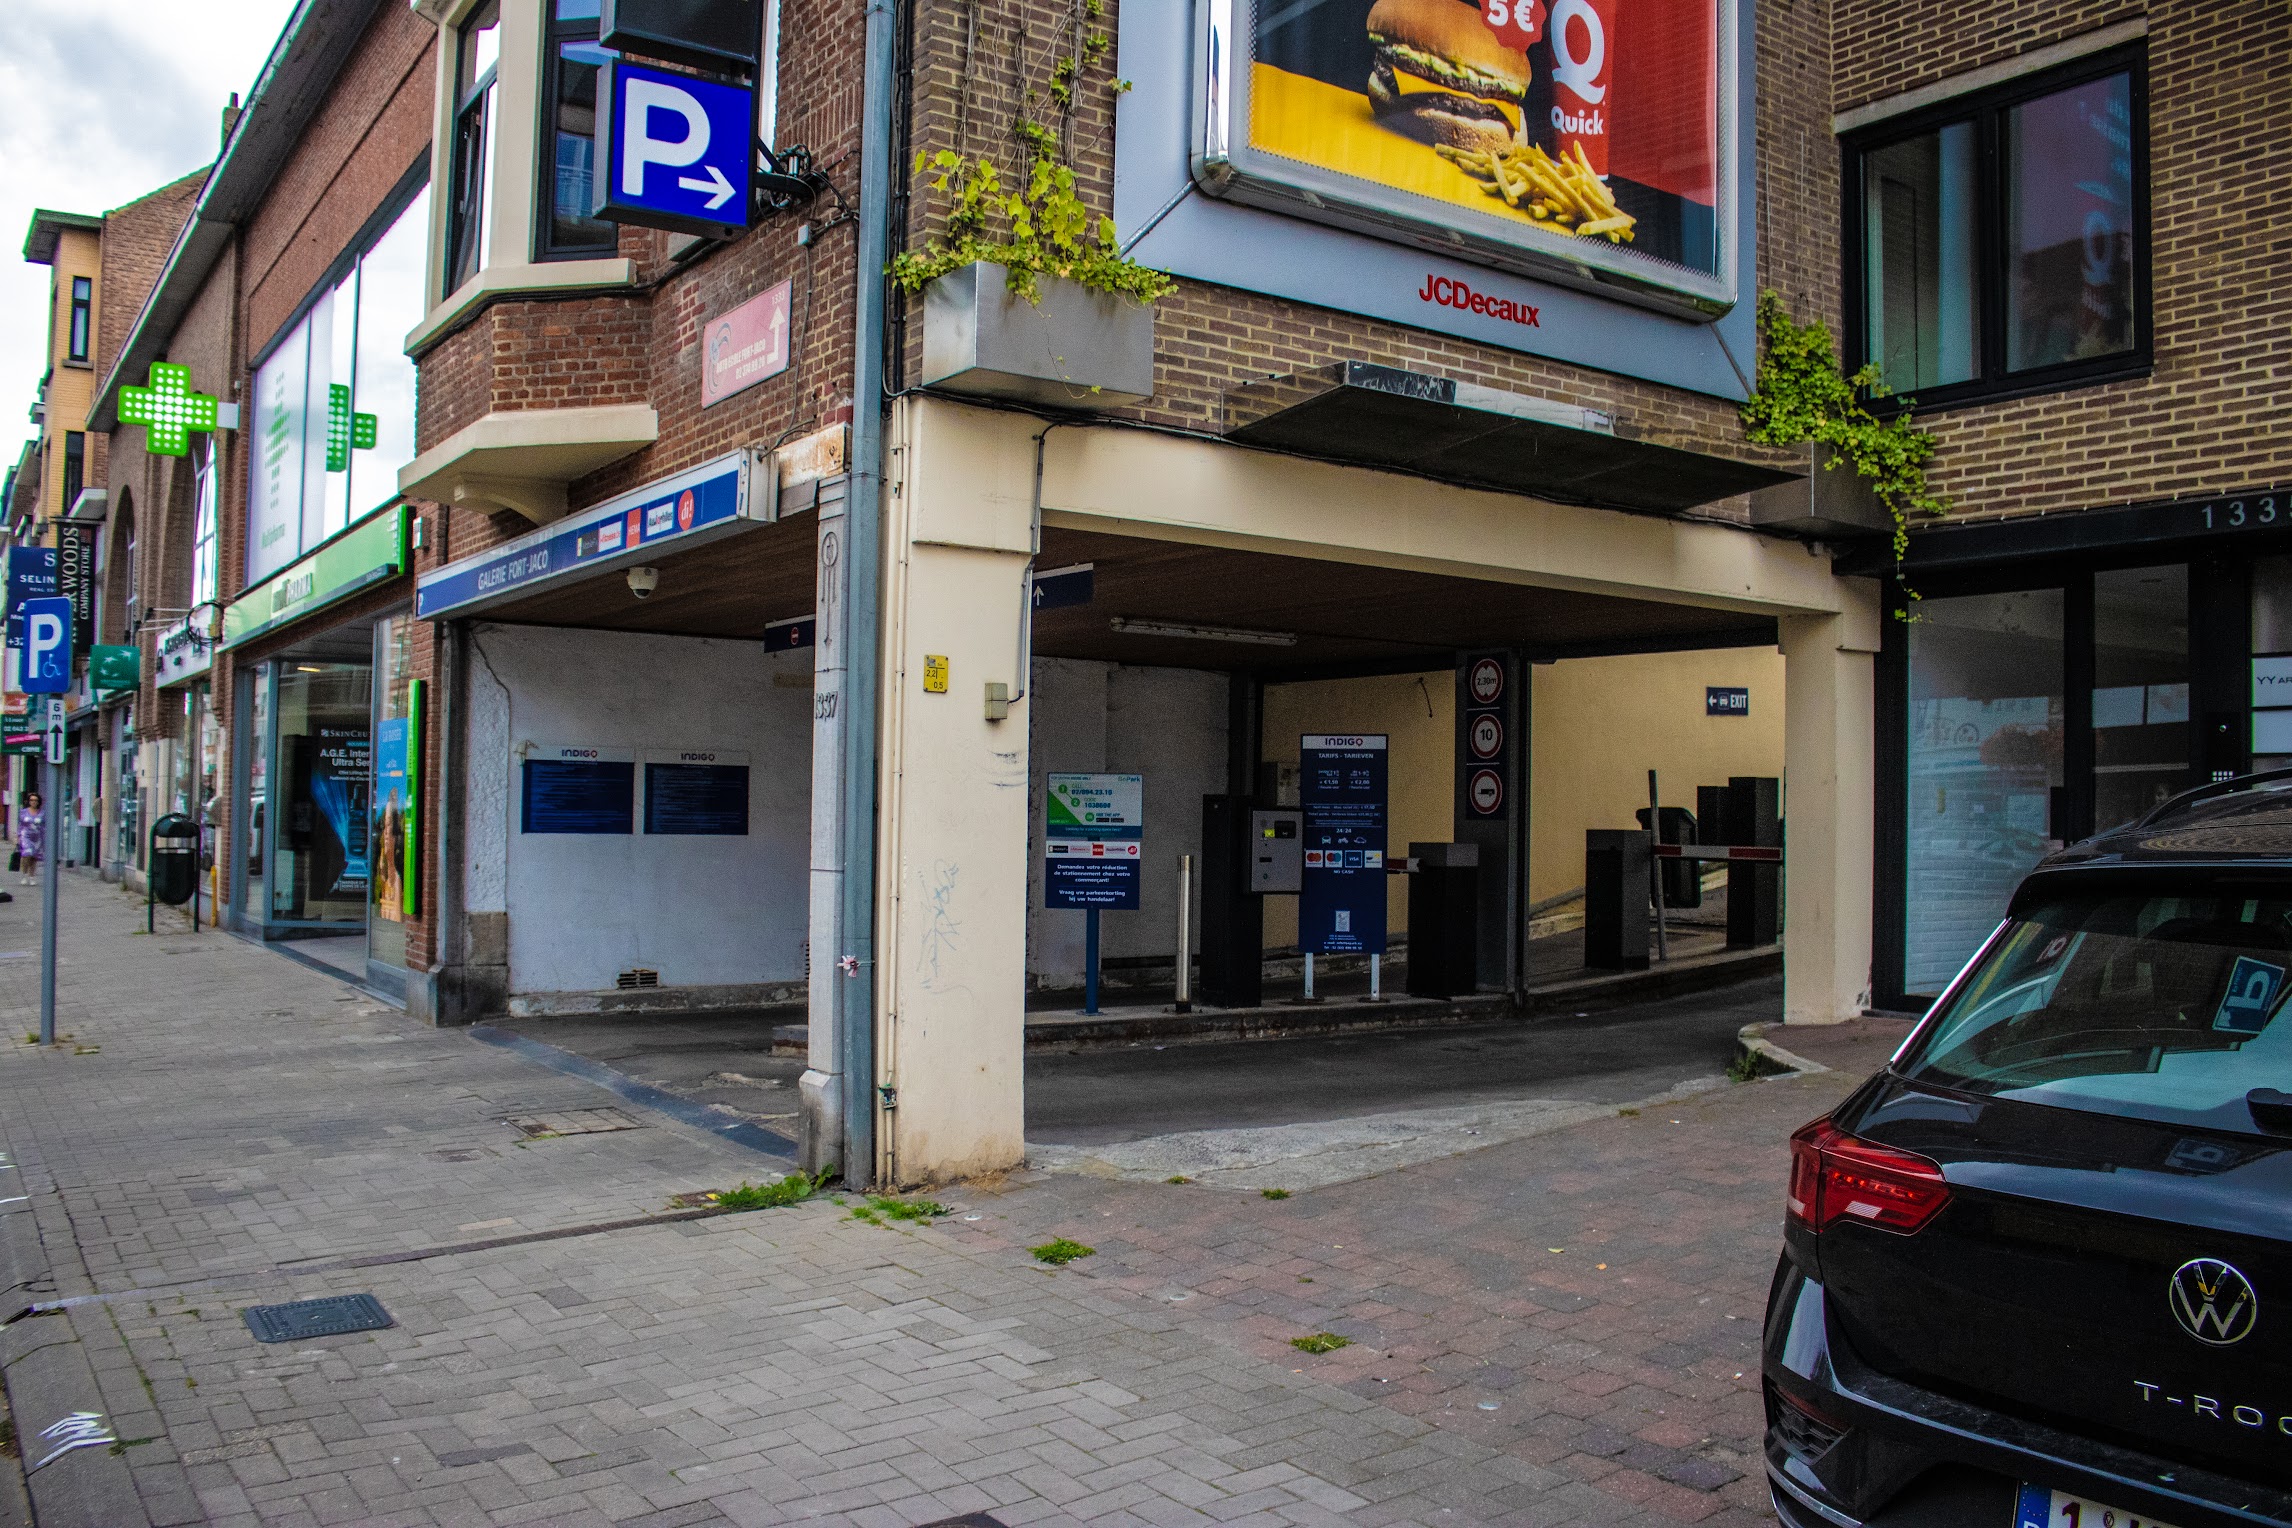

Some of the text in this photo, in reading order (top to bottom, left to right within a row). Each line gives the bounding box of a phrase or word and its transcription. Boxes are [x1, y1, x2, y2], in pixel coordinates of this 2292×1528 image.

[1551, 106, 1604, 135] Quick
[622, 77, 711, 197] P
[1418, 274, 1540, 328] JCDecaux
[681, 499, 693, 520] di!
[478, 549, 549, 590] GALERIE FORT-JACO
[80, 546, 91, 620] COMPANY STORE
[29, 613, 62, 679] P
[53, 703, 60, 712] 6
[1730, 694, 1747, 709] EXIT
[1325, 738, 1363, 747] INDIGO
[1480, 729, 1493, 741] 10
[320, 749, 347, 757] A.G.E.
[562, 749, 598, 758] INDIGO
[681, 752, 715, 762] INDIGO
[332, 758, 354, 766] Ultra
